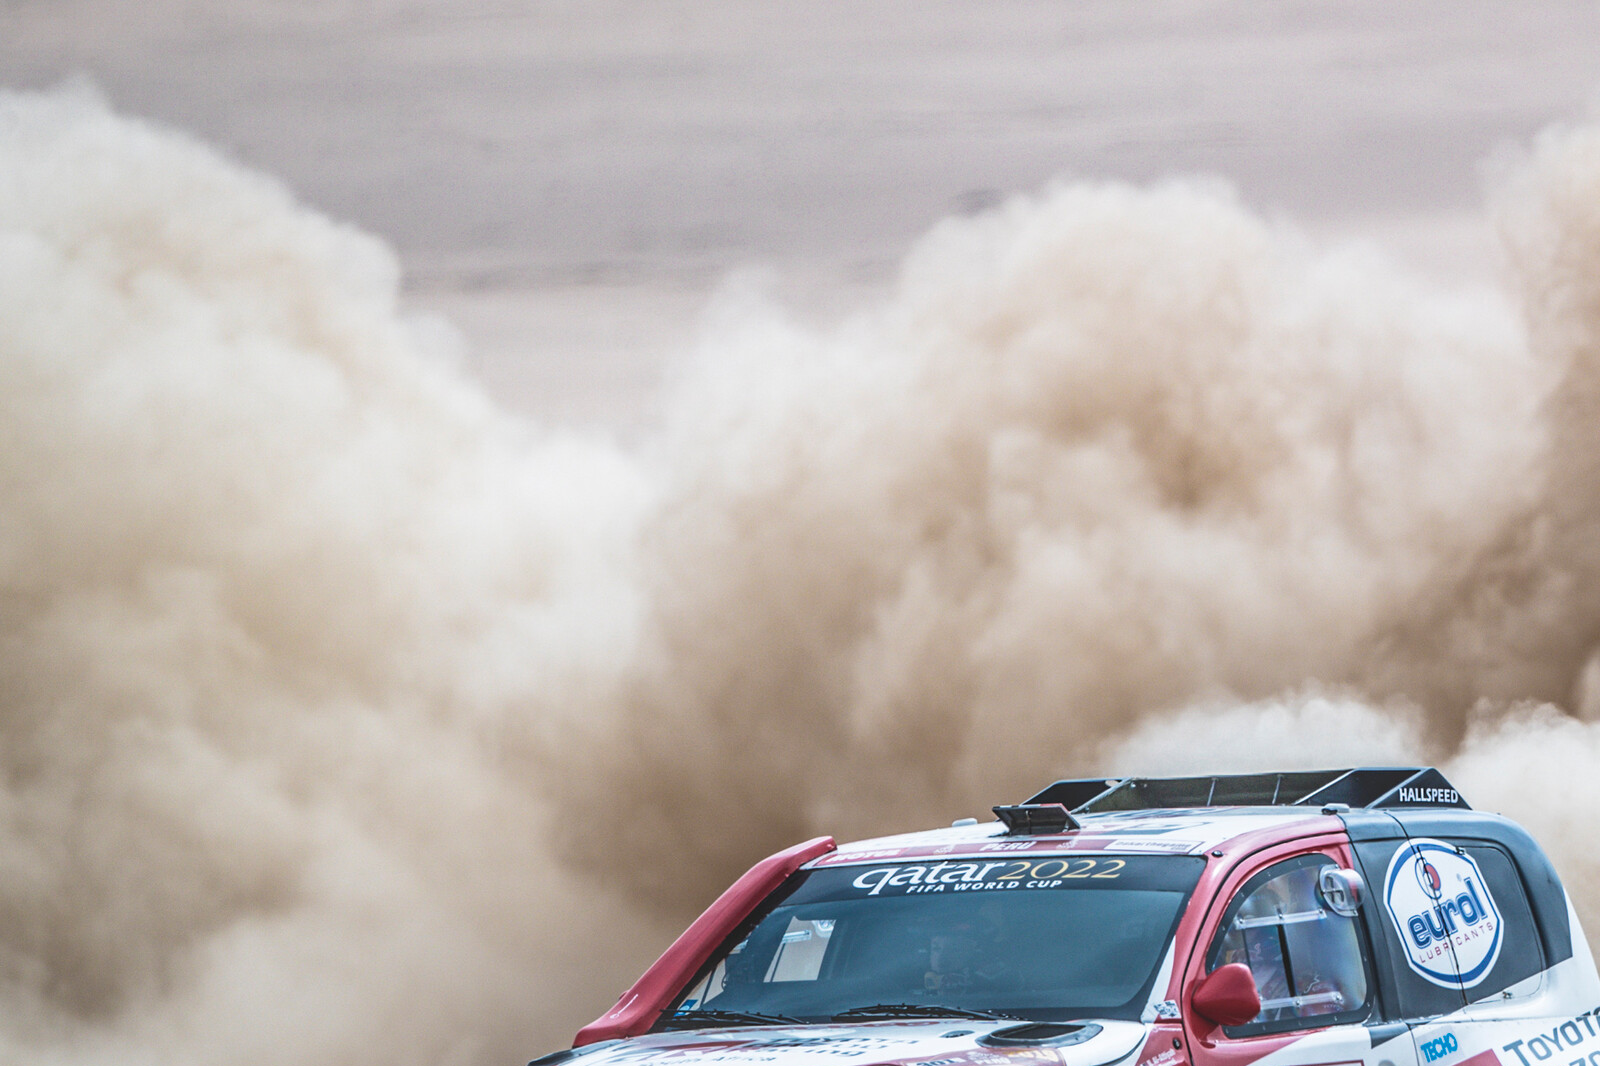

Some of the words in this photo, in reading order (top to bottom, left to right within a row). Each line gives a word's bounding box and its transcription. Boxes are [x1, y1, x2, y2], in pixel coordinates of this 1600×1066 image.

[1399, 787, 1459, 803] HALLSPEED
[853, 861, 1005, 895] qatar
[997, 860, 1126, 880] 2022
[906, 884, 945, 894] FIFA
[953, 881, 1019, 891] WORLD
[1026, 879, 1062, 889] CUP
[1408, 876, 1489, 949] eurol
[1419, 921, 1494, 964] LUBRICANTS
